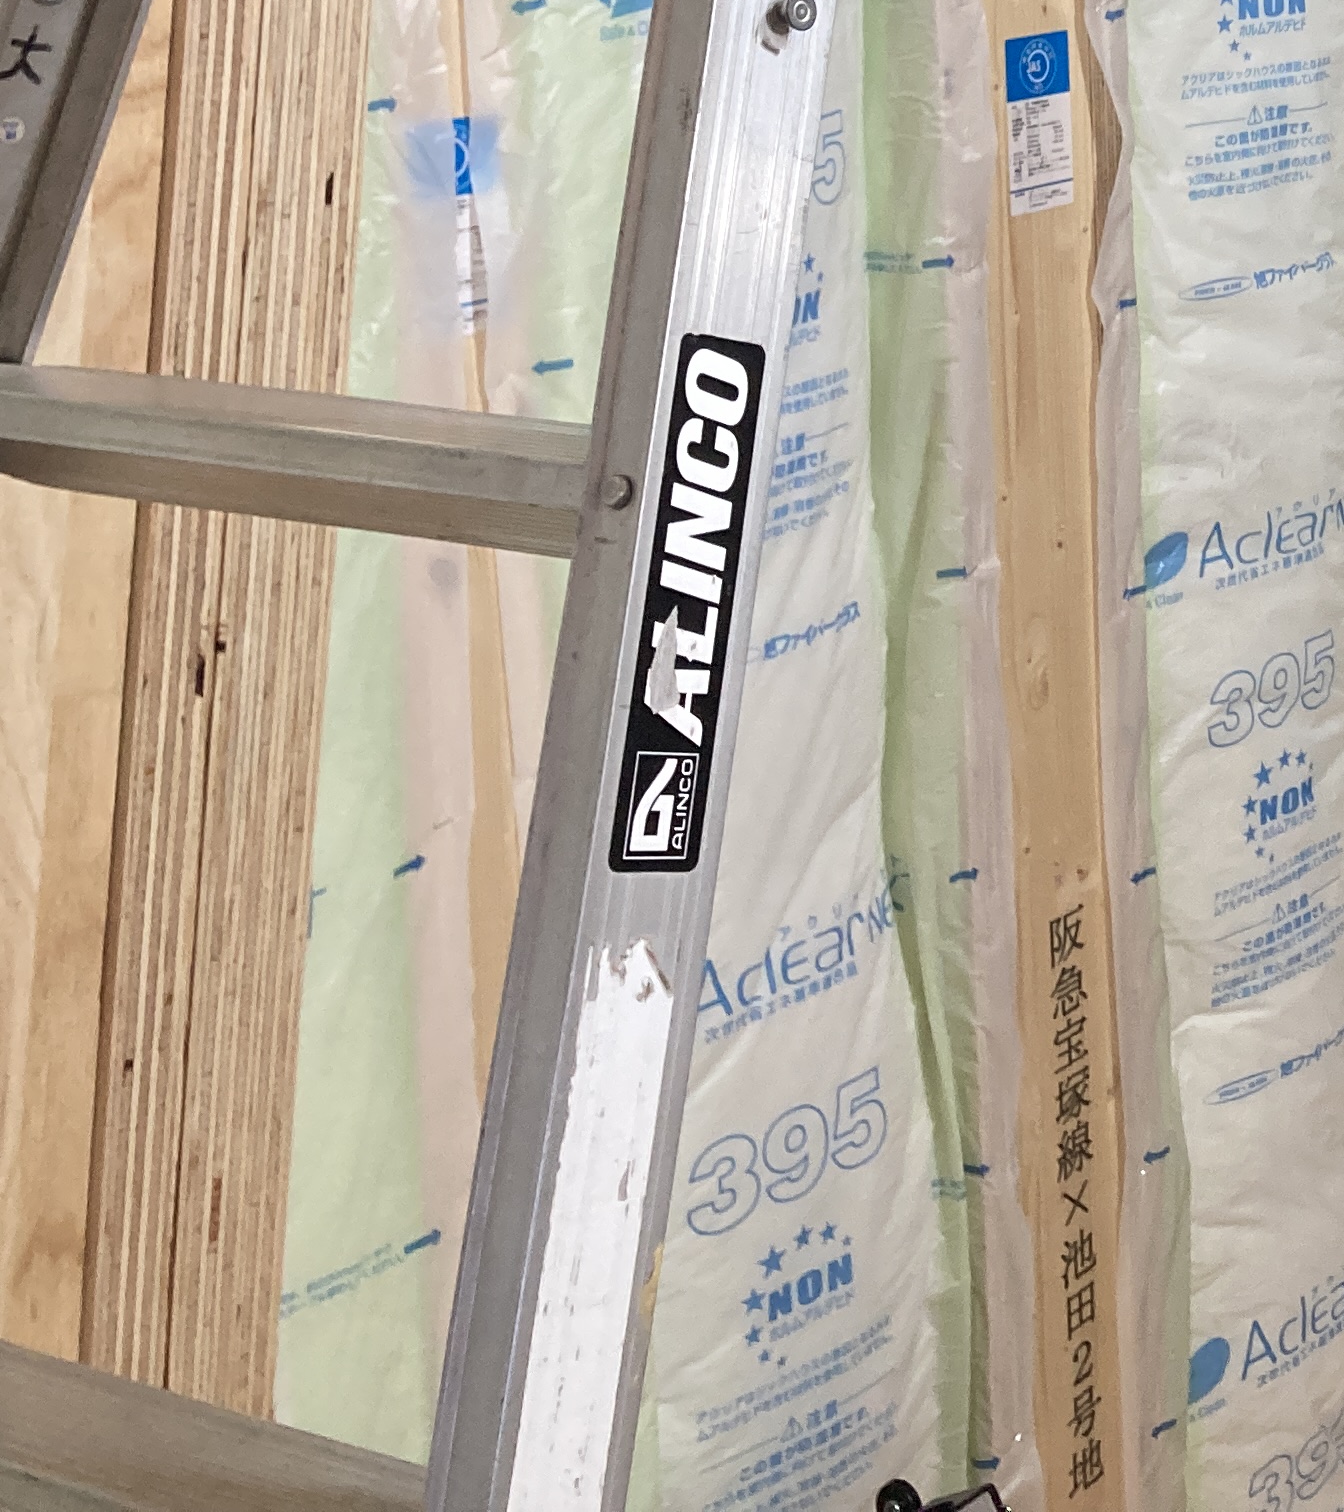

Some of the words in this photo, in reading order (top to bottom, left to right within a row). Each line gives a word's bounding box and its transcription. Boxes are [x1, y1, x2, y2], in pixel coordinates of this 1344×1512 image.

[643, 347, 750, 746] ALINCO
[1207, 629, 1335, 748] 395
[671, 758, 694, 849] ALINCO
[1258, 776, 1315, 825] NON
[686, 1065, 889, 1236] 395
[767, 1253, 854, 1322] NON
